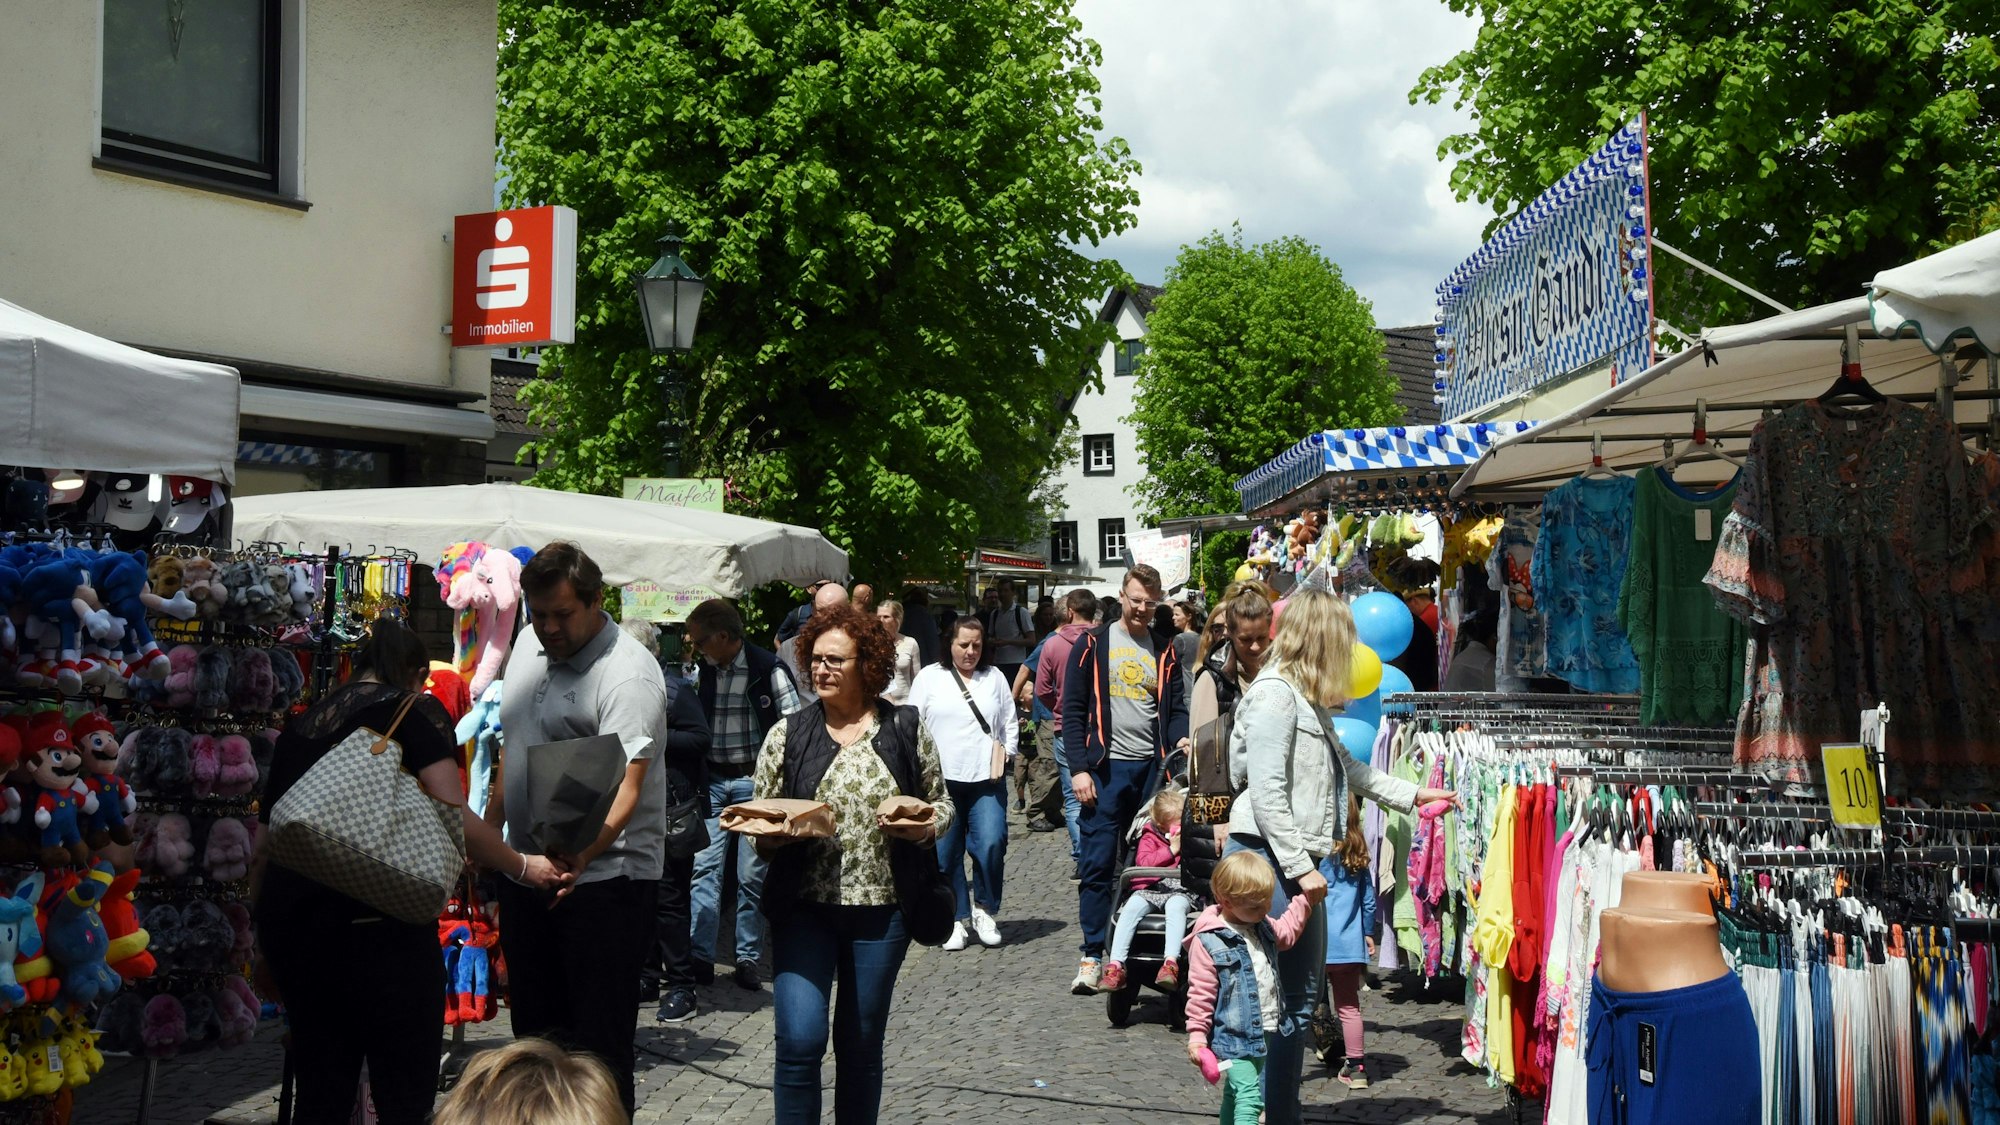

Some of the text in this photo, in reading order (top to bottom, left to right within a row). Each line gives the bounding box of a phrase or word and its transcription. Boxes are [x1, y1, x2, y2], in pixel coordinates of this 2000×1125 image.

[469, 319, 534, 336] Immobilien
[1465, 295, 1525, 381] Wiesn
[634, 484, 715, 507] Maifest
[625, 583, 659, 593] Gauk
